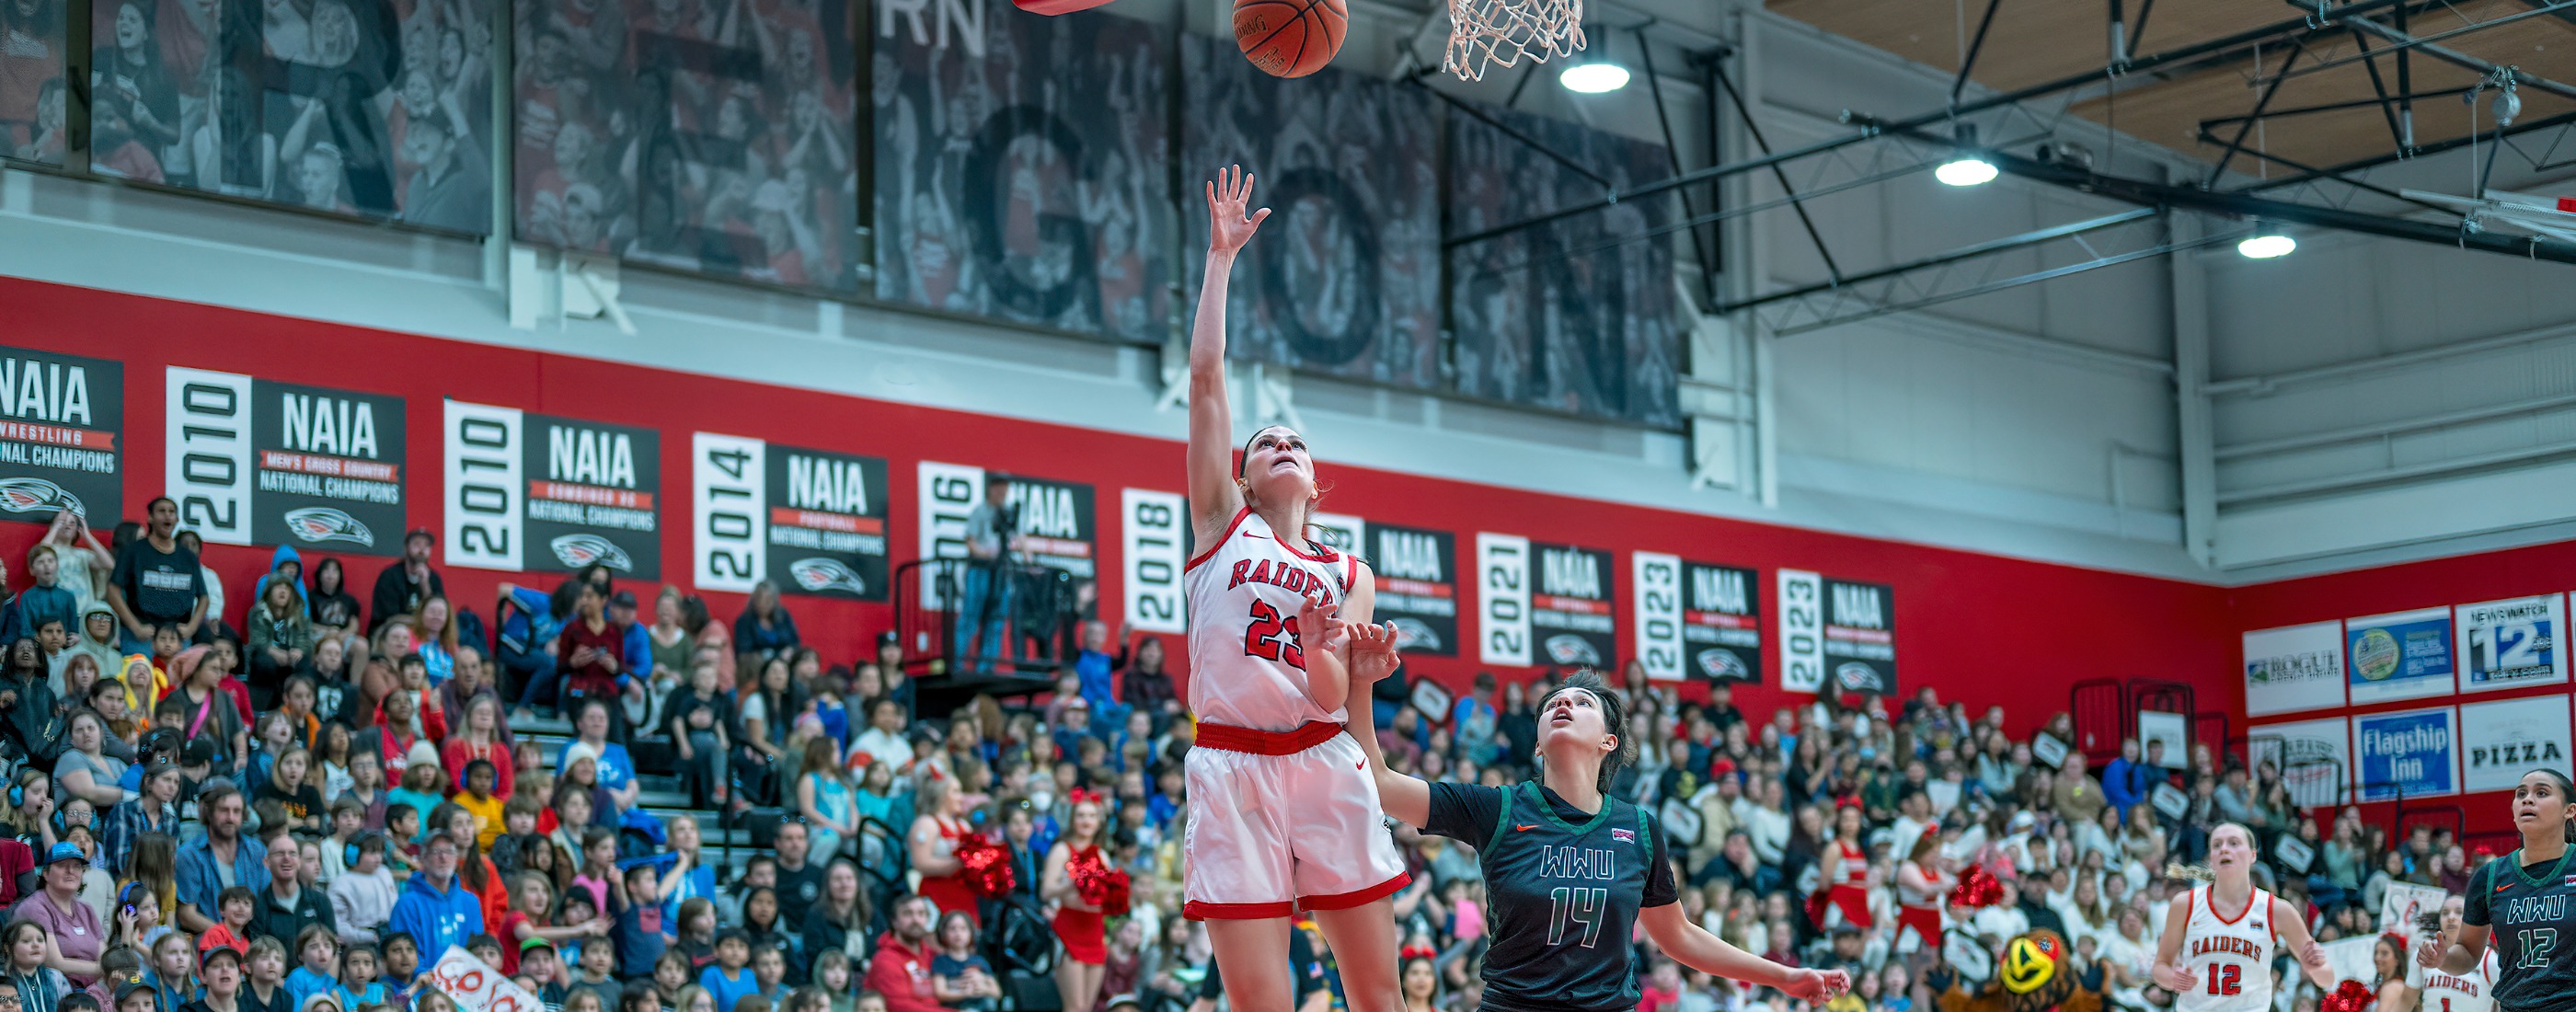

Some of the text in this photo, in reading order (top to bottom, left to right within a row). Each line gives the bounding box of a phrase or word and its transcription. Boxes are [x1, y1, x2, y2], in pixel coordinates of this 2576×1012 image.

[283, 392, 378, 459] NAIA
[32, 445, 115, 474] CHAMPIONS
[183, 383, 236, 530] 2010
[267, 452, 392, 479] MEN'S CROSS COUNTRY
[549, 425, 636, 489] NAIA
[260, 470, 399, 505] NATIONAL CHAMPIONS
[461, 419, 509, 556] 2010
[789, 454, 868, 515] NAIA
[587, 505, 655, 532] CHAMPIONS
[708, 448, 752, 578] 2014
[1137, 502, 1174, 620] 2018
[1379, 529, 1442, 582] NAIA
[1543, 548, 1601, 600] NAIA
[1489, 546, 1521, 655] 2021
[1693, 566, 1748, 615] NAIA
[1832, 582, 1884, 628] NAIA
[1644, 562, 1676, 671] 2023
[1788, 580, 1817, 684] 2023
[2471, 623, 2539, 670] 12
[2363, 724, 2447, 756] Flagship
[2472, 741, 2562, 768] PIZZA
[2391, 755, 2423, 781] Inn
[1540, 845, 1614, 880] WWU
[1547, 887, 1607, 949] 14
[2507, 894, 2566, 925] WWU
[2192, 936, 2261, 964] RAIDERS
[2516, 927, 2558, 969] 12
[2208, 962, 2241, 995] 12
